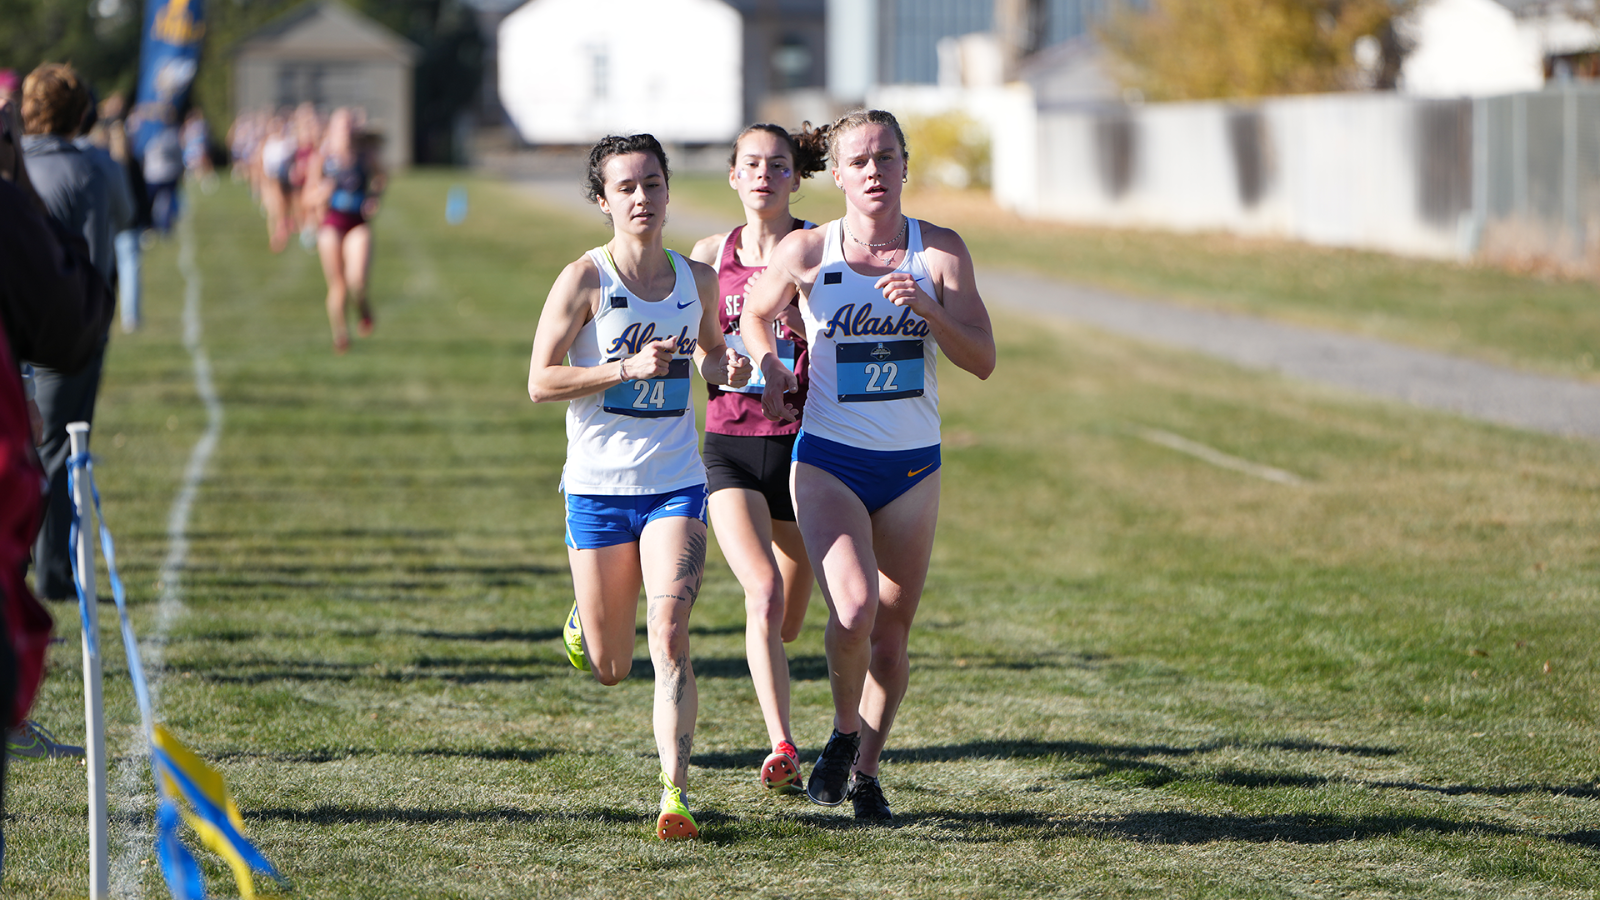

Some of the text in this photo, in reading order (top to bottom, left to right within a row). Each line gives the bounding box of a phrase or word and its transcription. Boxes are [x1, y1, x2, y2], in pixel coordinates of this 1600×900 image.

[824, 302, 930, 339] Alaska
[606, 322, 698, 355] Alka
[864, 362, 898, 392] 22
[632, 380, 665, 409] 24
